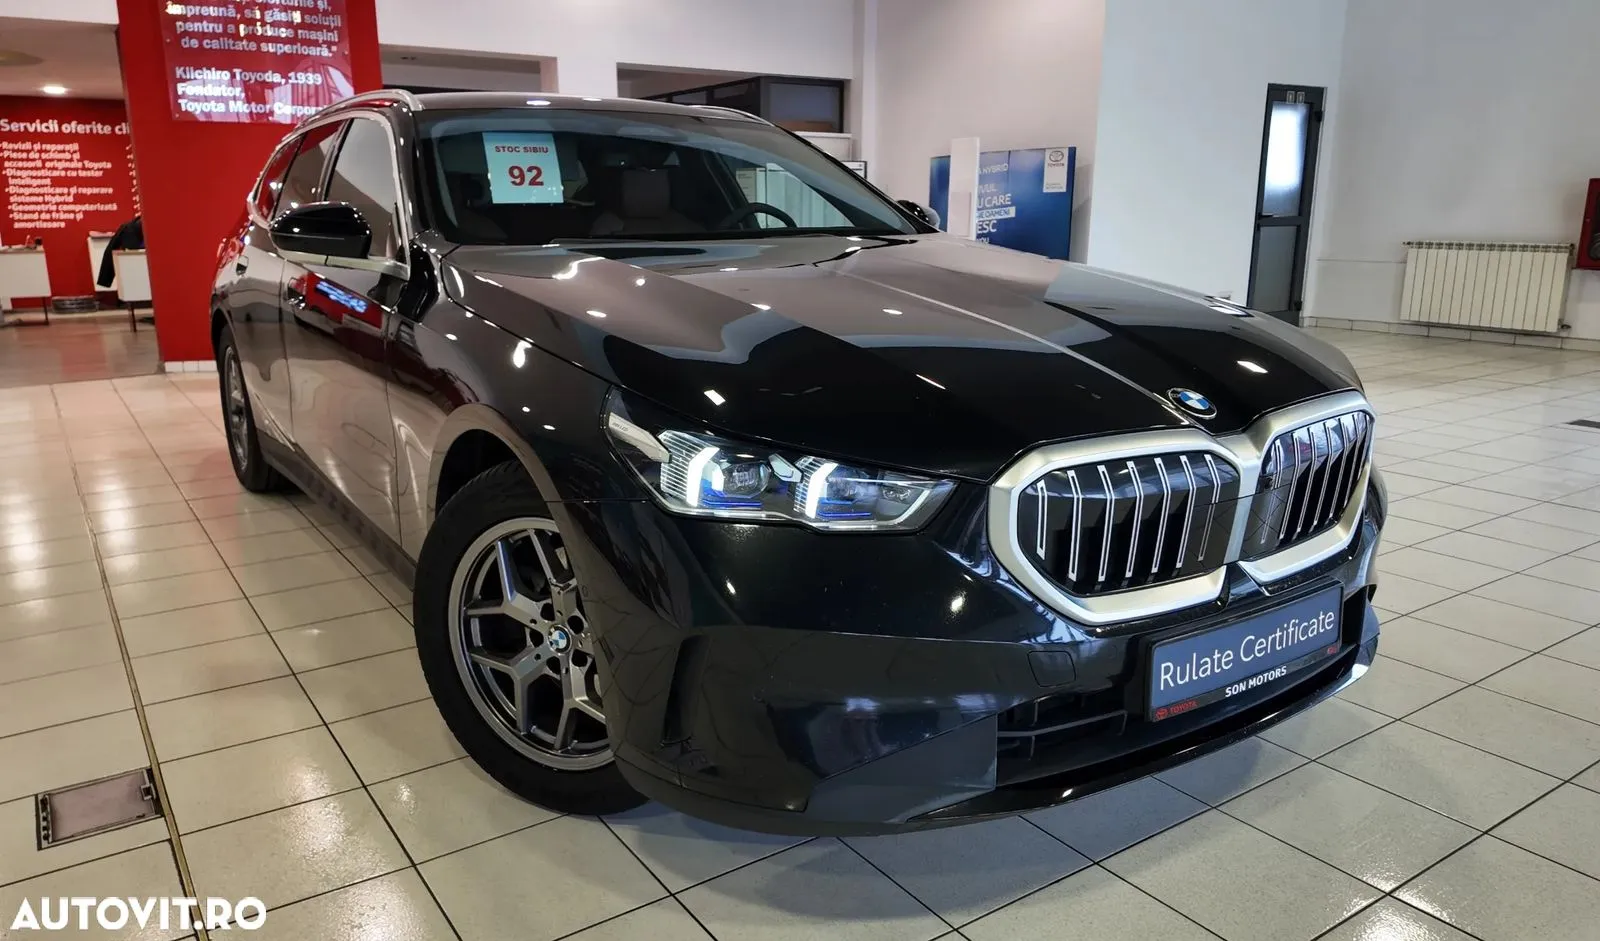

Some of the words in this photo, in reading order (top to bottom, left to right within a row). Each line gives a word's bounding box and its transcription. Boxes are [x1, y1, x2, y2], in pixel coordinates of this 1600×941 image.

[175, 20, 223, 34] pentru
[227, 24, 235, 33] a
[239, 23, 295, 37] produce
[181, 37, 199, 48] de
[203, 38, 257, 51] calitate
[175, 66, 231, 81] Kiichiro
[233, 68, 286, 85] Toyoda,
[289, 71, 322, 85] 1939
[176, 83, 246, 99] Fondator,
[178, 99, 226, 113] Toyota
[229, 99, 270, 114] Motor
[0, 118, 59, 133] Servicii
[61, 120, 112, 134] oferite
[495, 145, 520, 153] STOC
[84, 160, 112, 170] Toyota
[508, 165, 544, 187] 92
[984, 193, 1012, 207] CARE
[1160, 652, 1234, 690] Rulate
[1239, 610, 1335, 662] Certificate
[1225, 680, 1246, 698] SON
[1248, 666, 1287, 689] MOTORS
